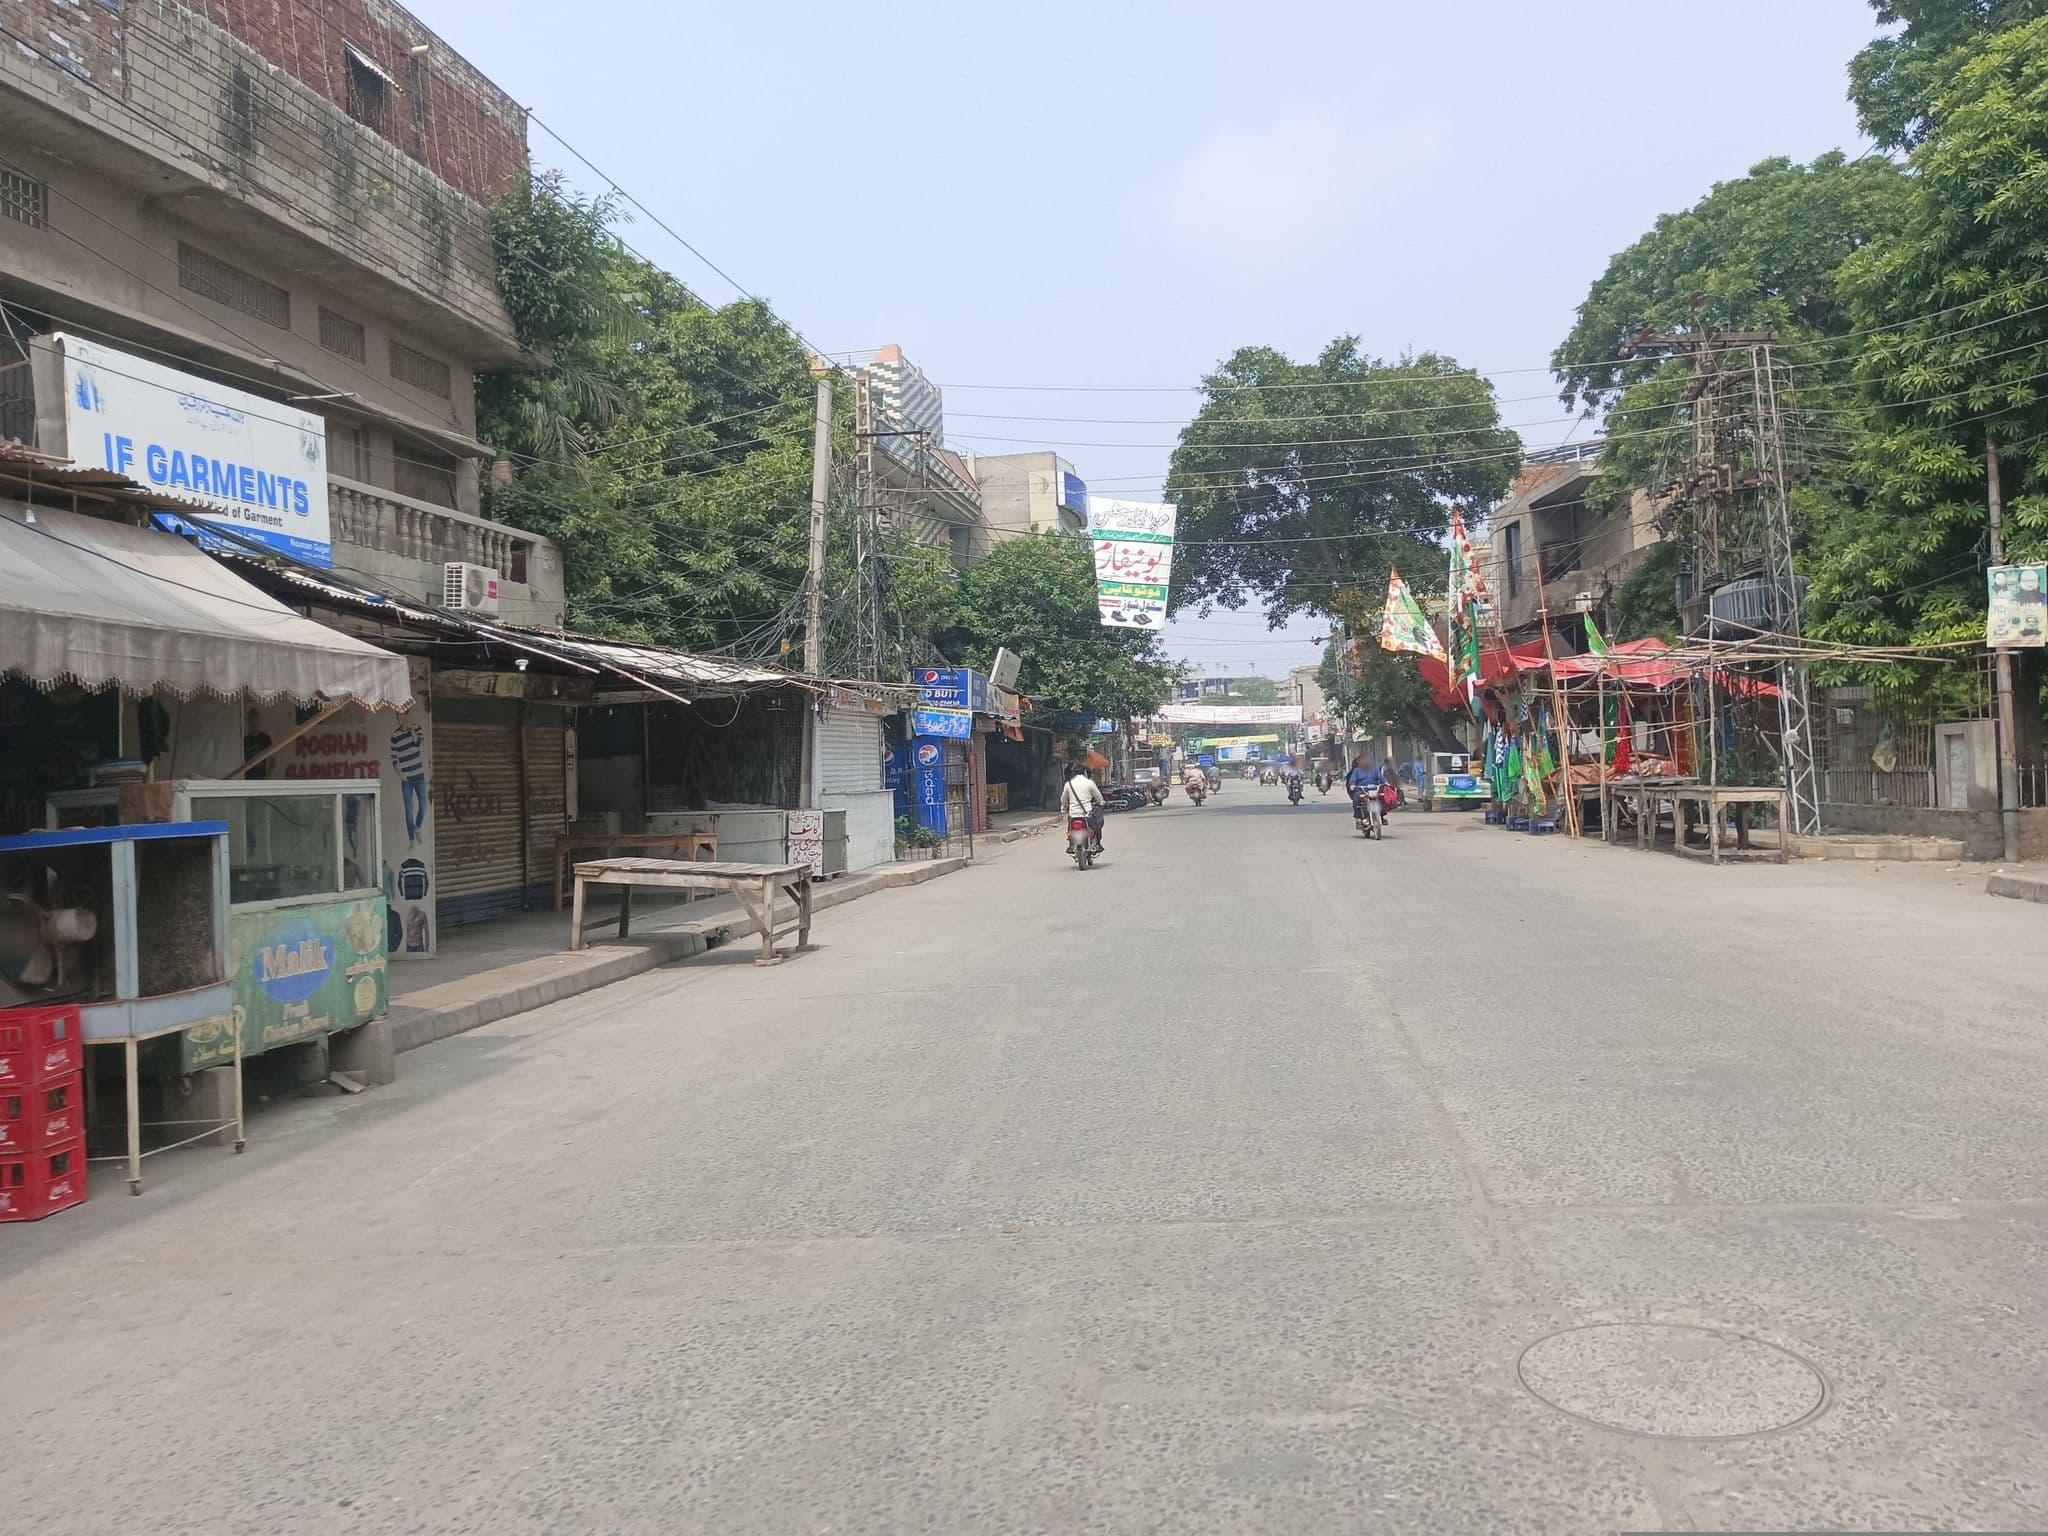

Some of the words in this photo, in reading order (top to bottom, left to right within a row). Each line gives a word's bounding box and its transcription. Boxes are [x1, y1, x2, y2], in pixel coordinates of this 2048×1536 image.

[104, 432, 134, 475] IF
[146, 443, 310, 517] GARMENTS
[232, 508, 241, 518] of
[244, 509, 283, 527] Garment
[934, 689, 959, 698] BUTT
[295, 732, 369, 759] ROSHAN
[923, 769, 937, 805] pepsi
[262, 938, 329, 982] Malik
